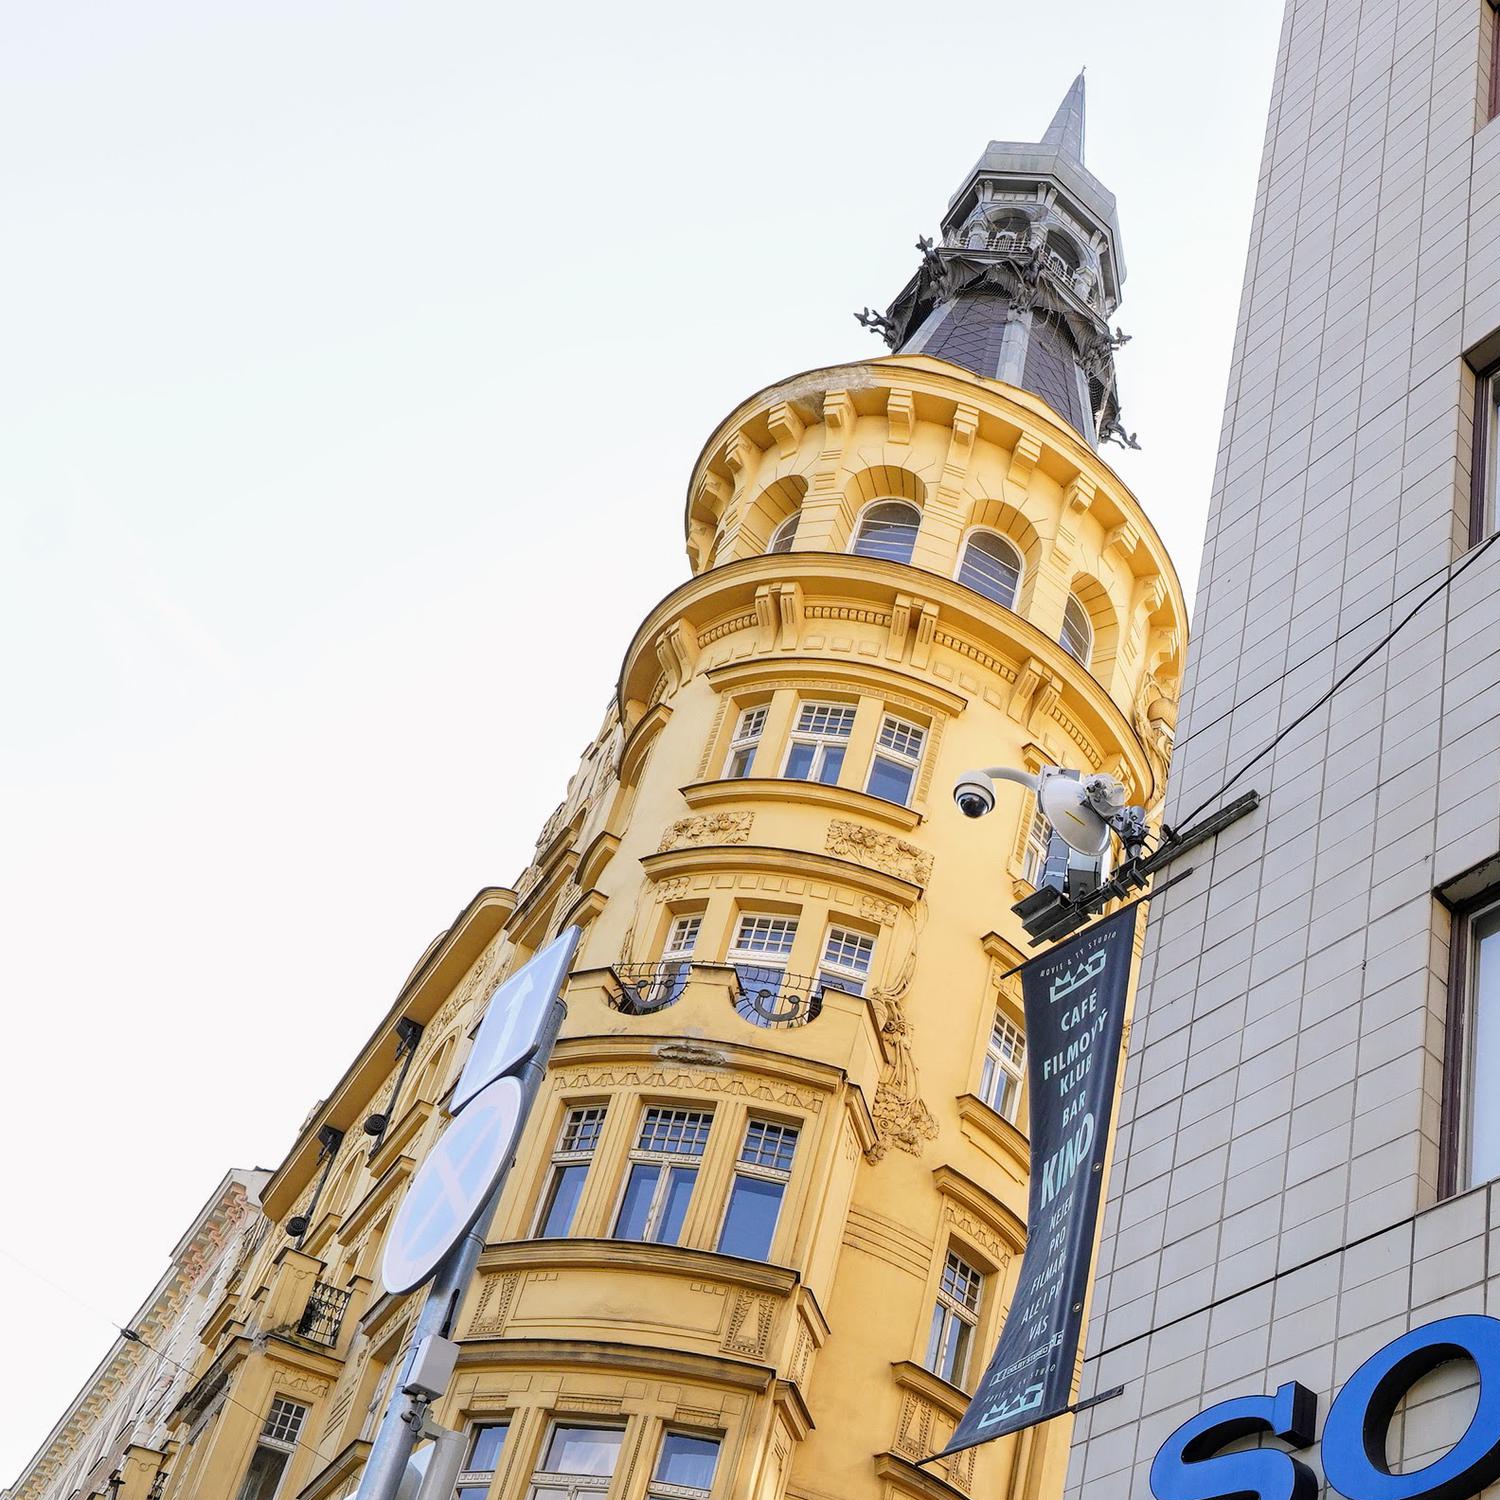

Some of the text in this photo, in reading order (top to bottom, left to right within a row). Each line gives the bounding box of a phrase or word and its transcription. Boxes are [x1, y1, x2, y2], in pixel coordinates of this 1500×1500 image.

[1088, 931, 1117, 950] STUDIO
[1061, 987, 1098, 1032] CAFÉ
[1043, 1008, 1108, 1081] FILMOVÝ
[1060, 1053, 1093, 1097] KLUB
[1062, 1091, 1086, 1128] BAR
[1049, 1226, 1066, 1256] PRO
[1028, 1314, 1049, 1342] VÁS
